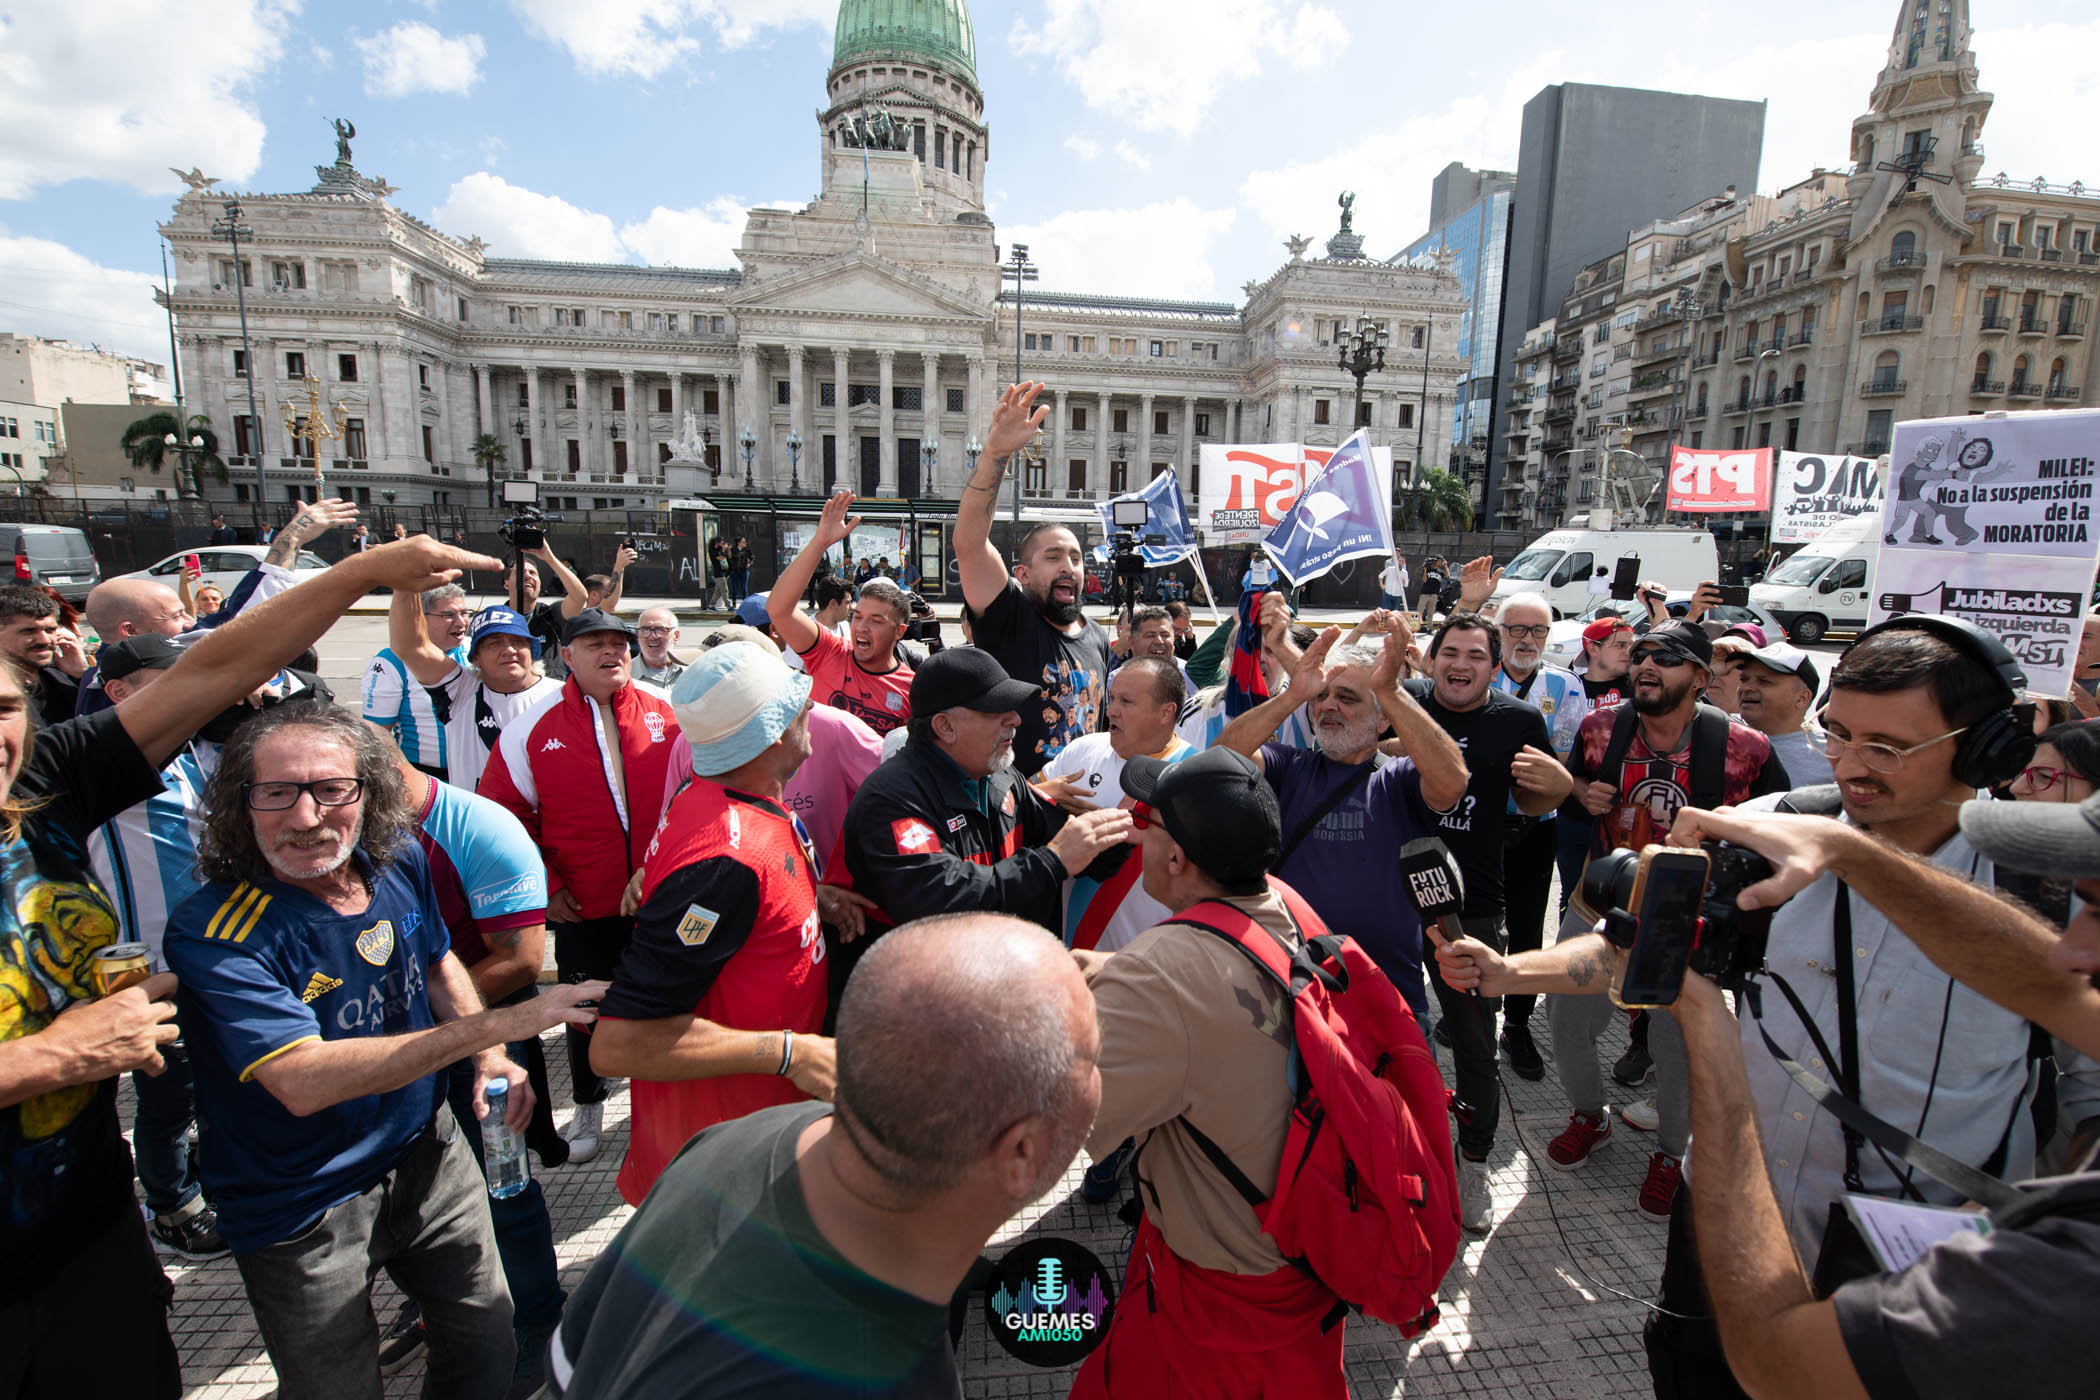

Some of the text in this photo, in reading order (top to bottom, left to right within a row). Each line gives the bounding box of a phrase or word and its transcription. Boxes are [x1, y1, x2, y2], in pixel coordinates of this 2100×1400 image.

[2038, 457, 2095, 479] MILEI:
[1936, 480, 2093, 505] No a la suspensión
[2044, 501, 2090, 521] de la
[1983, 523, 2088, 543] MORATORIA
[1948, 590, 2073, 614] Jubiladxs
[1974, 614, 2071, 636] izquierda
[1438, 815, 1472, 832] ALLÁ
[302, 977, 344, 1004] adidas
